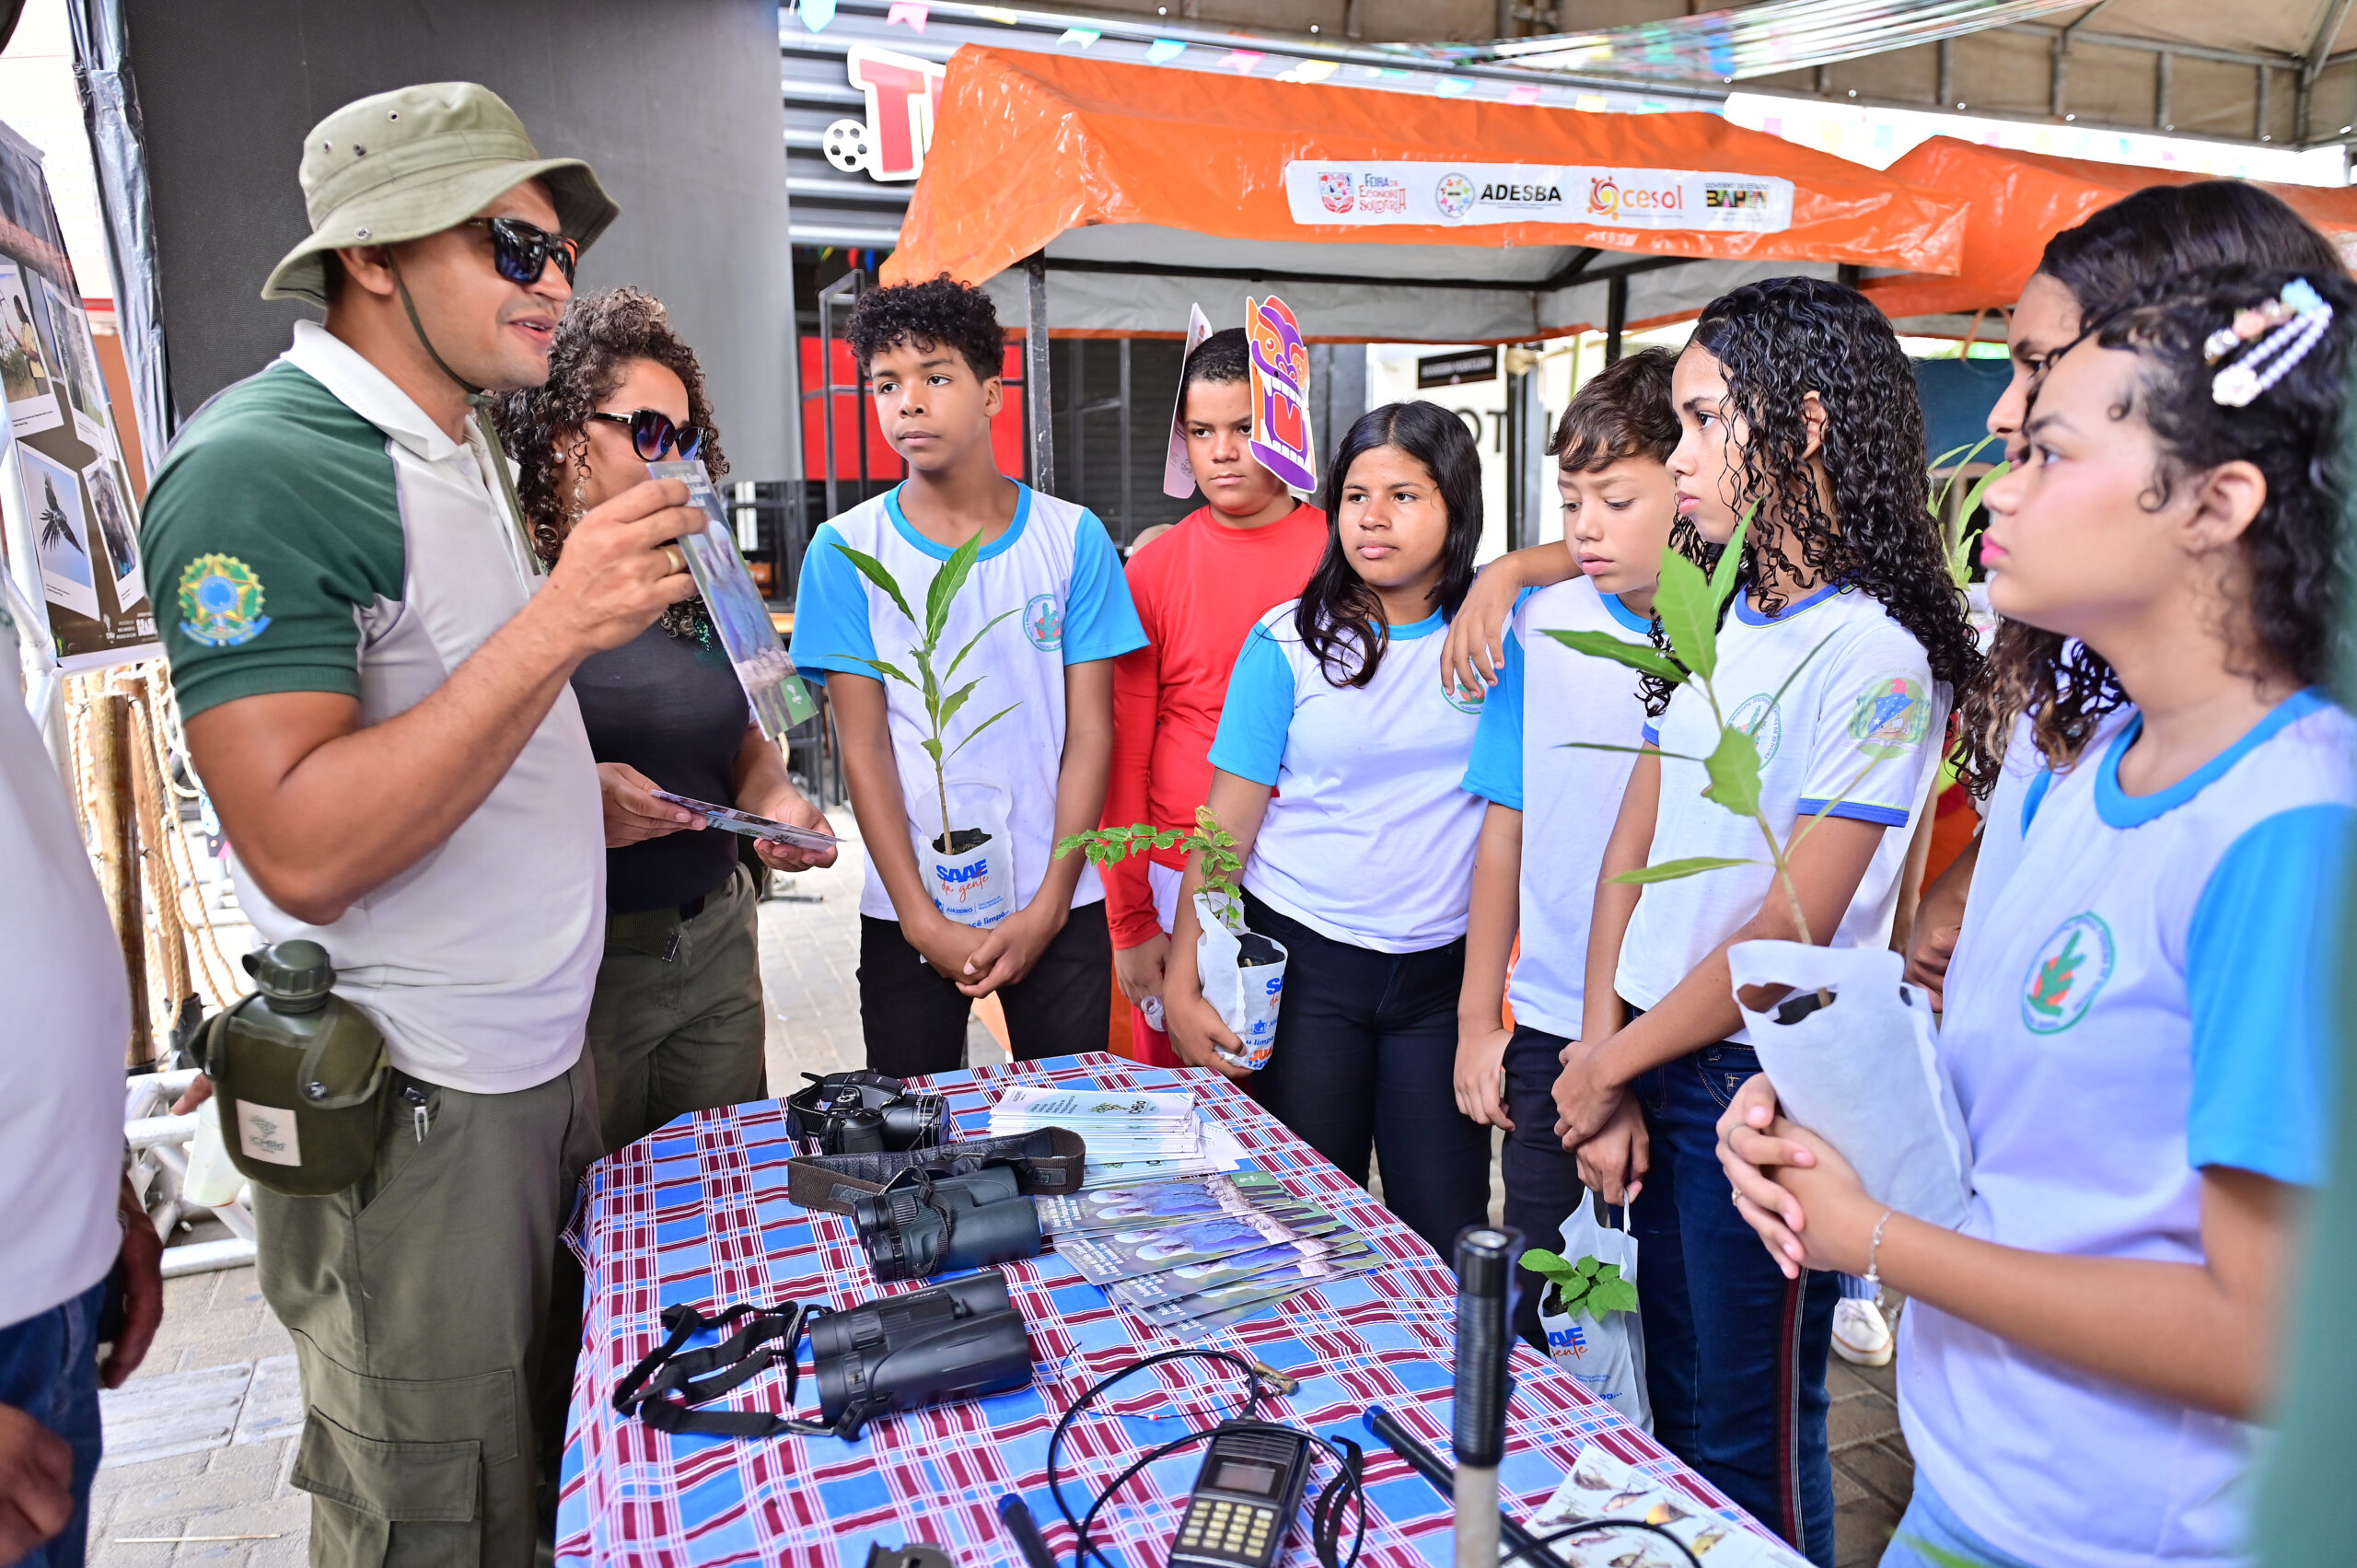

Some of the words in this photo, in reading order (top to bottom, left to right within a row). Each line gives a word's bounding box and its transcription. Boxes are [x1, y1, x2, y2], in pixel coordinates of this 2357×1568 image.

[1480, 183, 1562, 202] ADESBA
[1622, 184, 1683, 210] cesol
[1706, 190, 1768, 207] BAHIA
[936, 859, 988, 883] SAAE
[959, 867, 989, 903] gente
